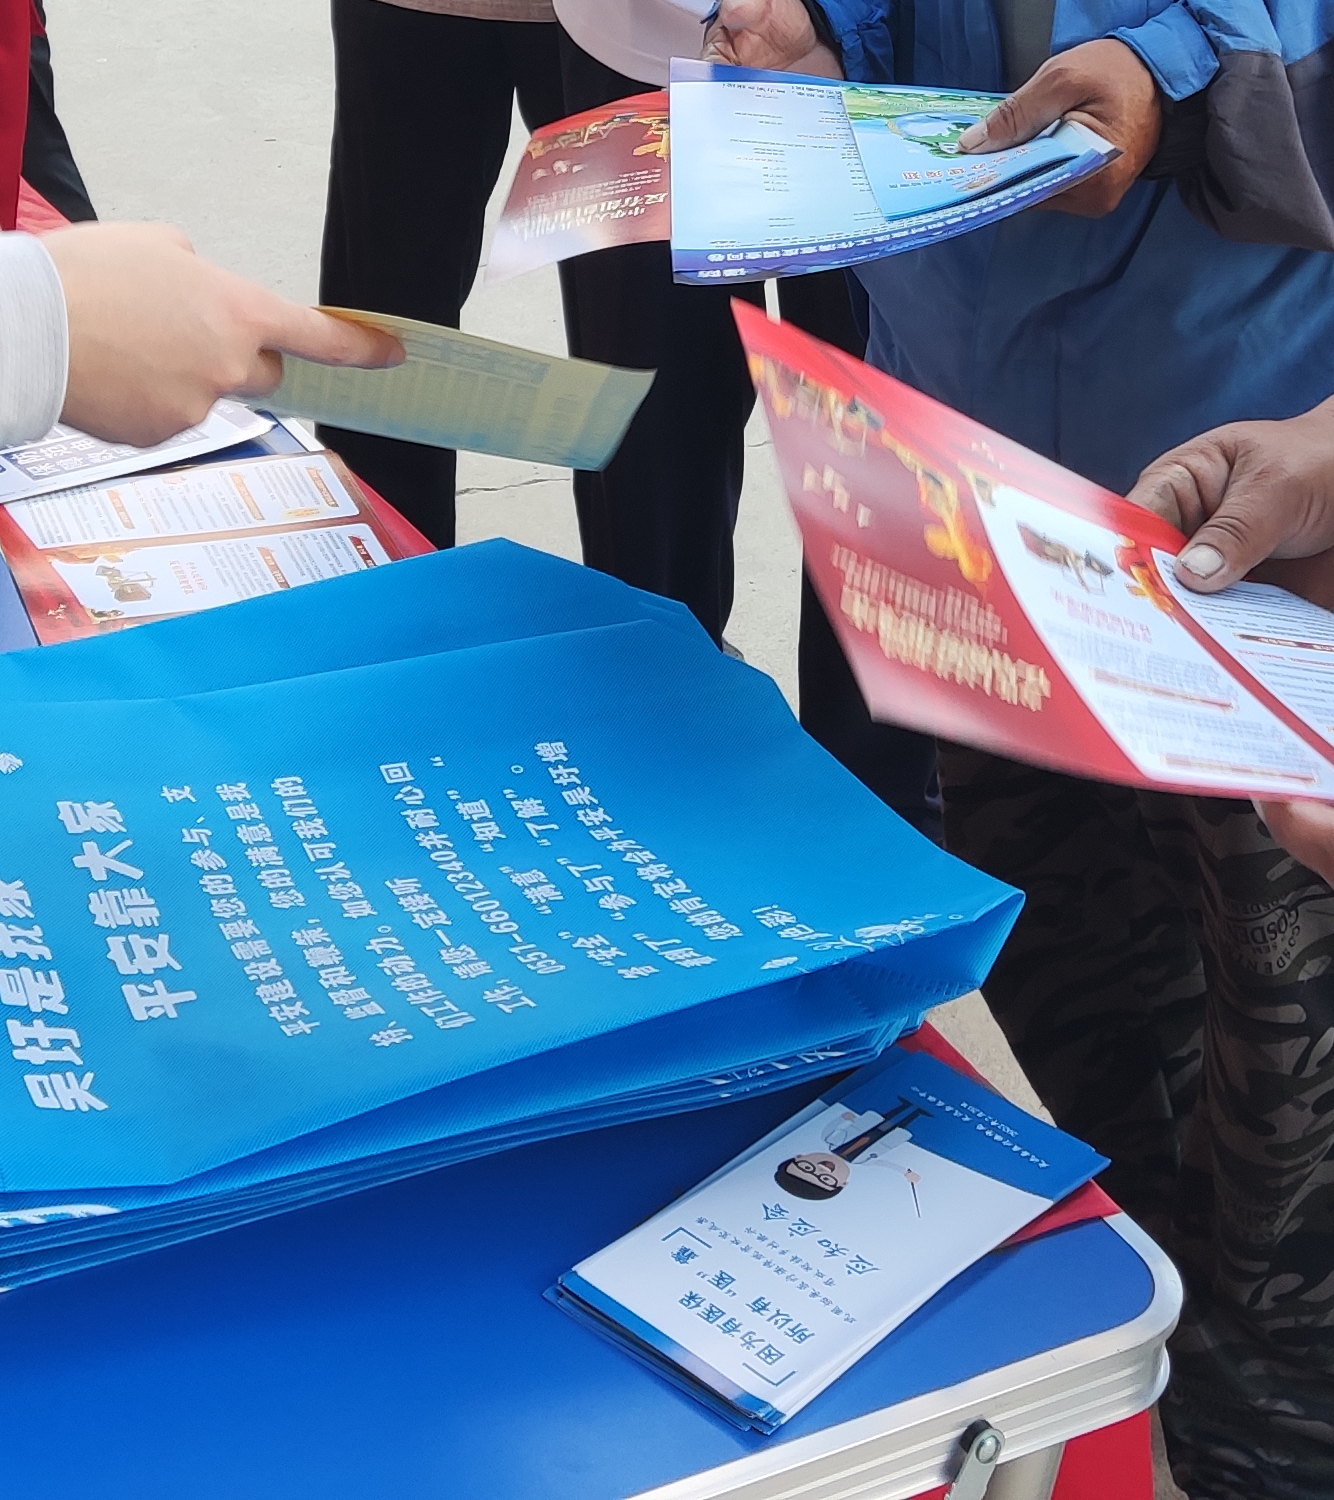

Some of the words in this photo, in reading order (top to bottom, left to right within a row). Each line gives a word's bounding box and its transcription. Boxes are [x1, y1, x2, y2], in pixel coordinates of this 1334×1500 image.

[57, 802, 196, 1020] 平安靠大家
[762, 1202, 883, 1278] 应知应会
[678, 1289, 786, 1366] 因为有医保
